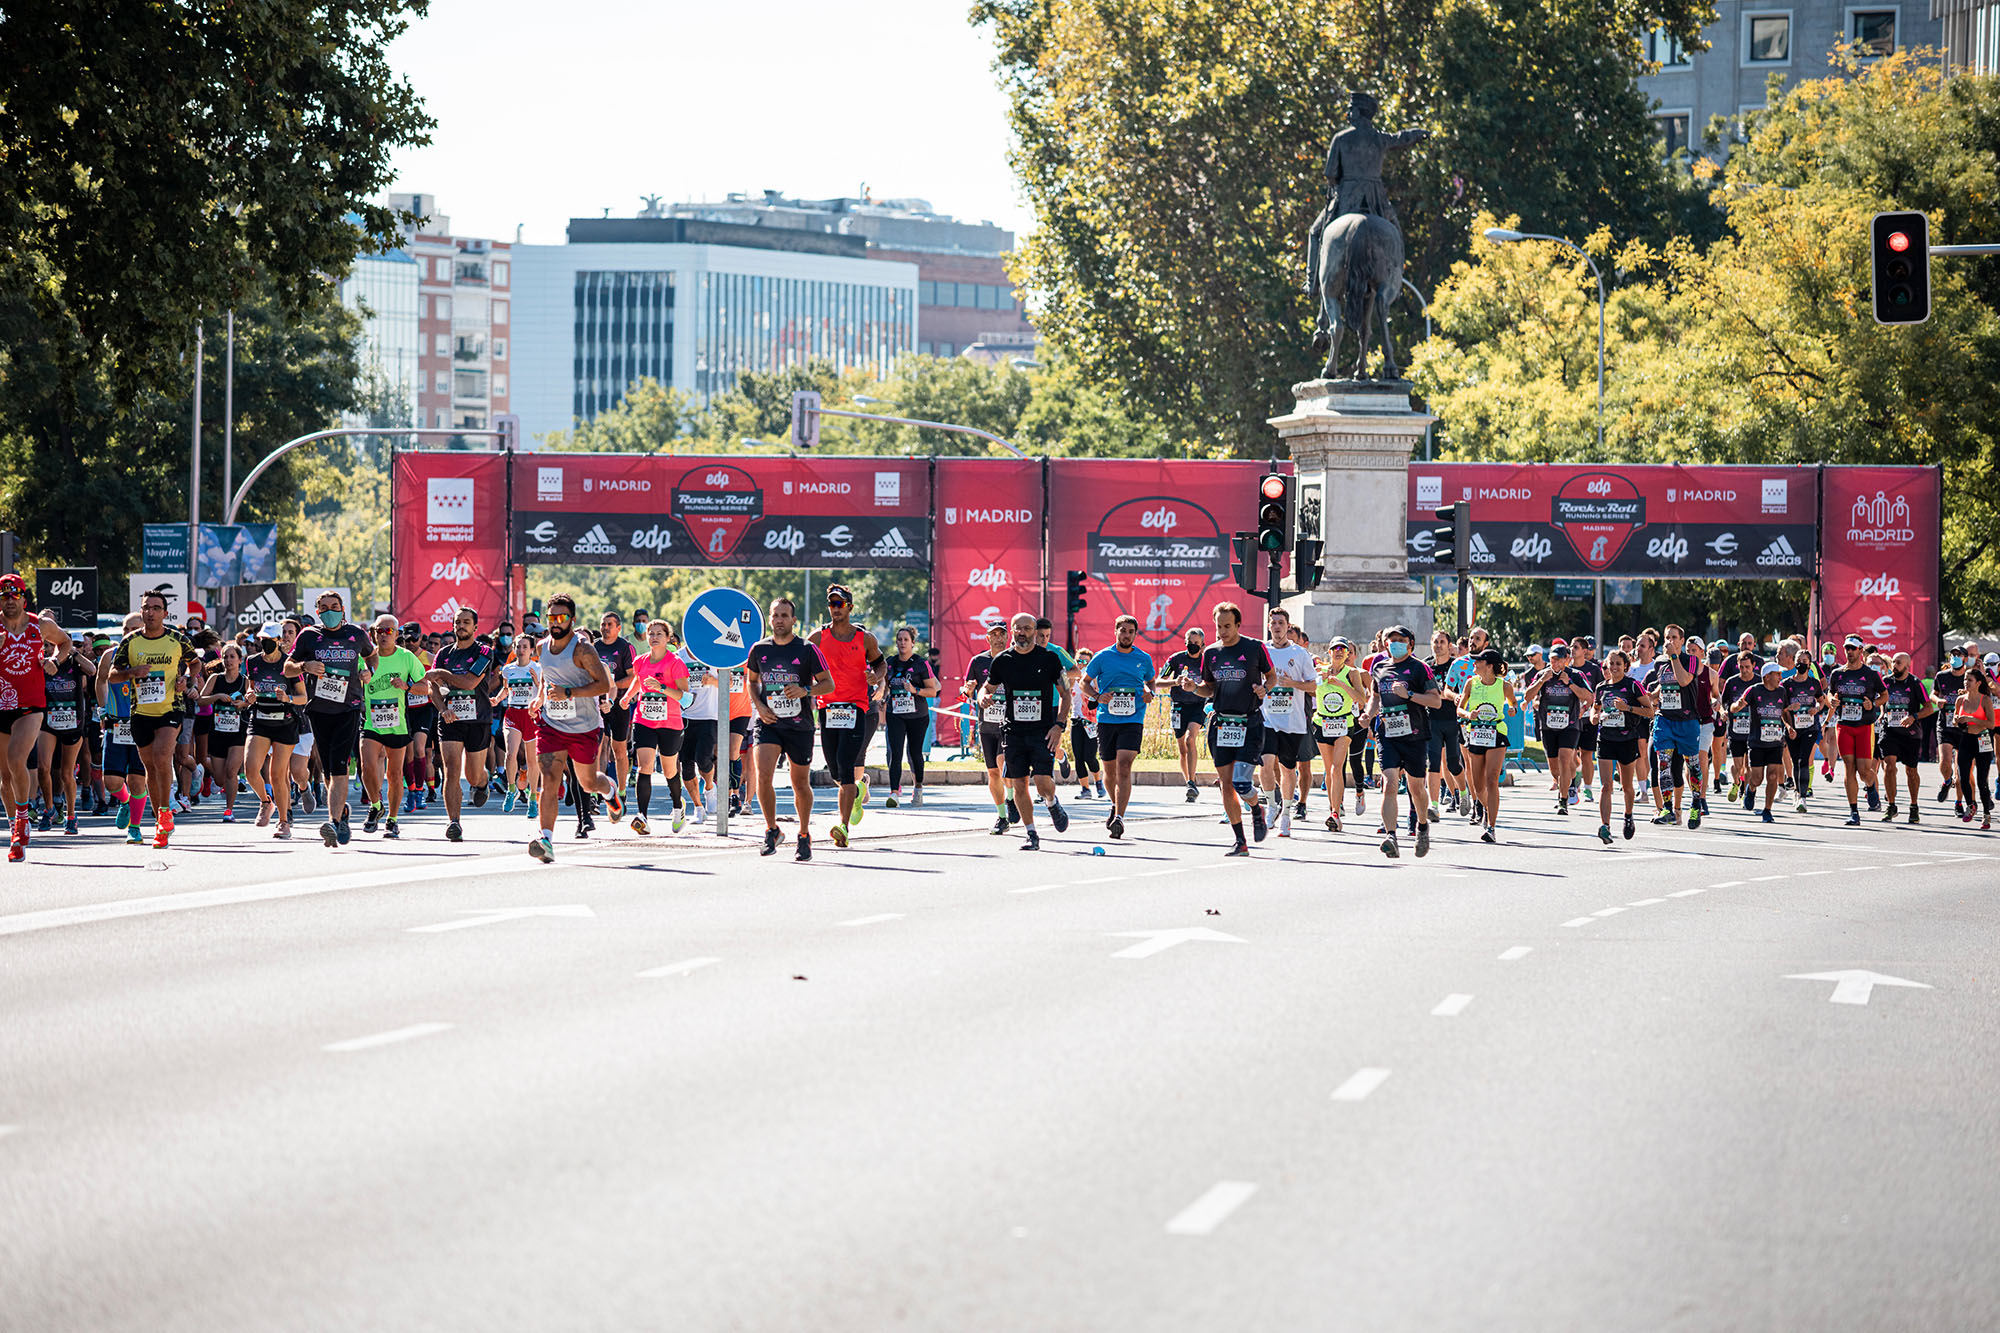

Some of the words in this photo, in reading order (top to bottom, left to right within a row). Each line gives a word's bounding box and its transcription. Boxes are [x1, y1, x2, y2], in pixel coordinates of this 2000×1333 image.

[705, 471, 729, 488] edp
[600, 480, 651, 492] MADRID
[800, 483, 851, 494] MADRID
[1587, 478, 1611, 496] edp
[1480, 488, 1532, 500] MADRID
[1684, 490, 1736, 501] MADRID
[966, 509, 1032, 523] MADRID
[1141, 506, 1176, 532] edp
[630, 524, 672, 554] edp
[764, 525, 806, 556] edp
[1846, 529, 1914, 541] MADRID
[573, 542, 617, 554] adidas
[870, 546, 914, 558] adidas
[1510, 532, 1553, 564] edp
[1646, 532, 1688, 564] edp
[1108, 559, 1162, 568] RUNNING
[1164, 560, 1206, 568] SERIES
[1756, 554, 1802, 566] adidas
[431, 557, 470, 586] edp
[968, 564, 1006, 592] edp
[50, 576, 84, 600] edp
[1861, 572, 1900, 601] edp
[10, 644, 34, 653] INFINITY
[315, 650, 356, 660] MADRID
[140, 686, 160, 696] 28784
[322, 682, 342, 693] 28994
[774, 700, 794, 708] 29151
[376, 713, 394, 722] 29198
[988, 707, 1005, 716] 28711
[119, 728, 131, 736] 288
[1222, 732, 1241, 740] 29193
[1474, 732, 1492, 740] F22553
